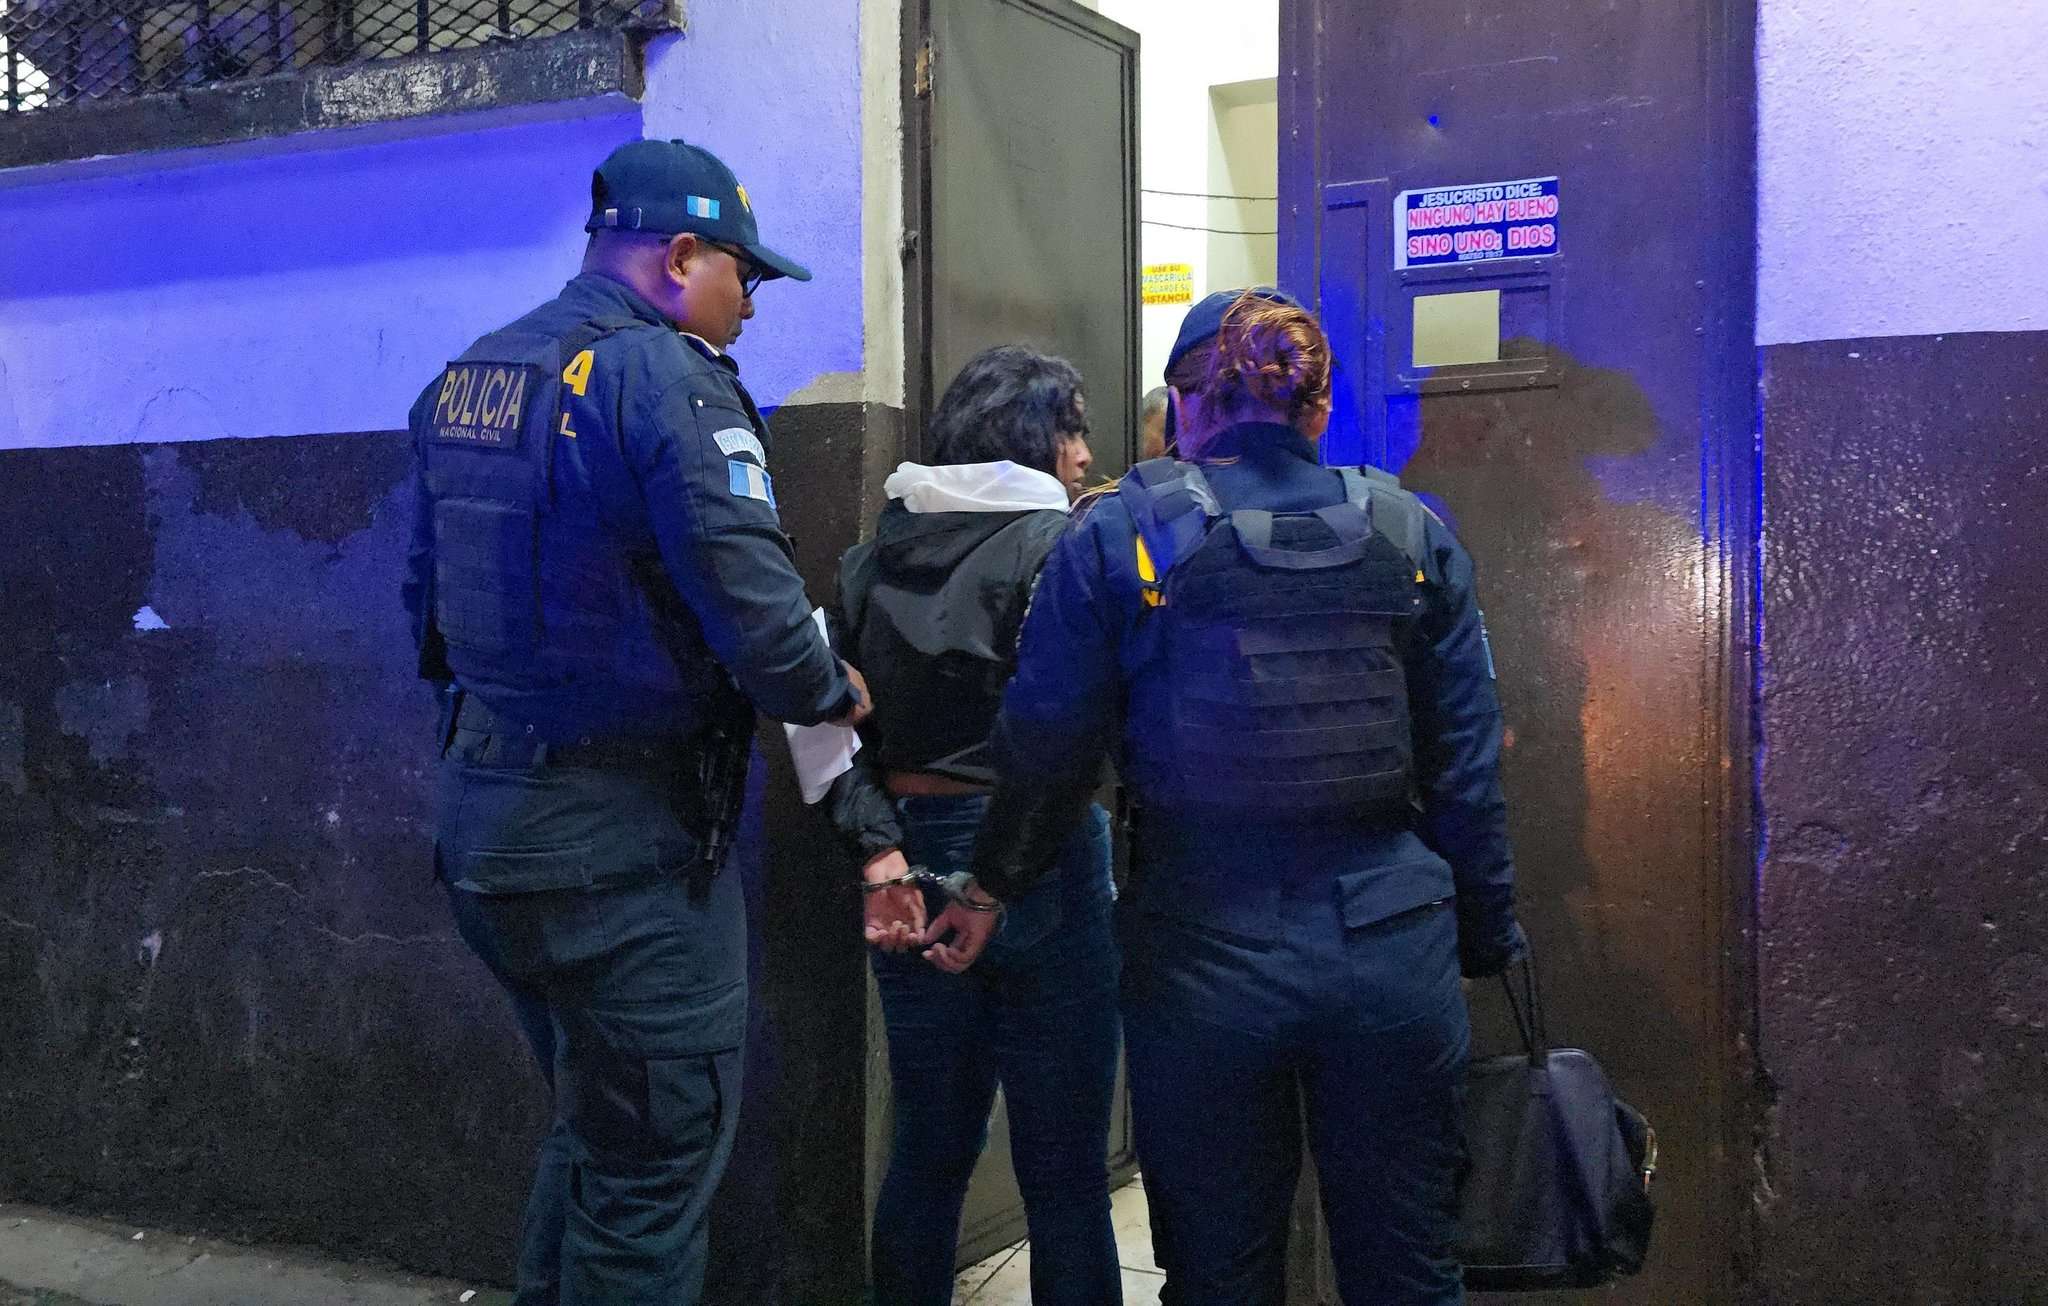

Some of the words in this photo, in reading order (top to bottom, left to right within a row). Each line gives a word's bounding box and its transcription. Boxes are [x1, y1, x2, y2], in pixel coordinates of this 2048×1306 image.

[1419, 186, 1502, 208] JESUCRISTO
[1506, 182, 1542, 200] DICE:
[1408, 203, 1474, 230] NINGUNO
[1475, 200, 1505, 223] HAY
[1506, 196, 1558, 220] BUENO
[1408, 234, 1453, 257] SINO
[1509, 225, 1554, 248] DIOS
[433, 367, 527, 430] POLICIA
[440, 426, 476, 440] NACIONAL
[481, 428, 501, 441] CIVIL
